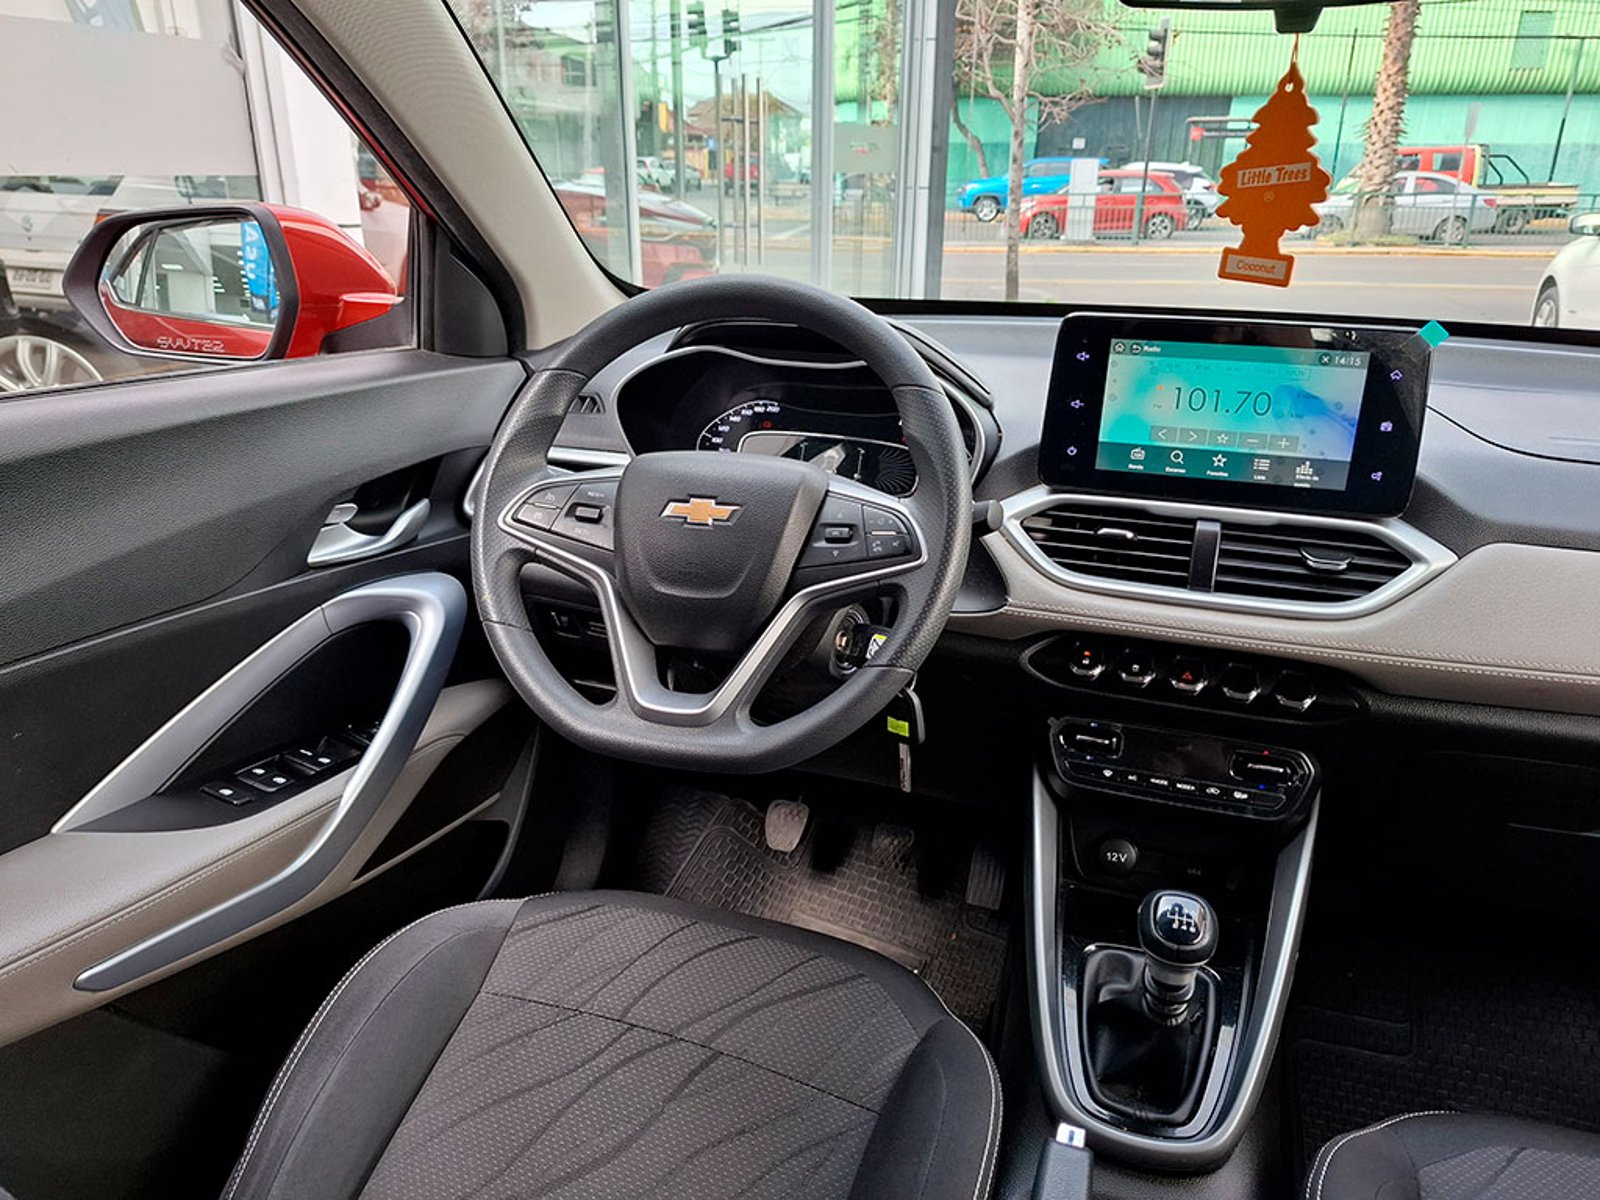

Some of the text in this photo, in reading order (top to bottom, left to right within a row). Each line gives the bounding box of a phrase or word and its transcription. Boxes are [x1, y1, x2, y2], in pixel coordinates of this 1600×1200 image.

[1241, 166, 1307, 185] Little Trees
[1236, 260, 1276, 274] Coconut
[1335, 356, 1361, 367] 14:15
[1174, 386, 1272, 417] 101.70
[1106, 852, 1128, 863] 12V
